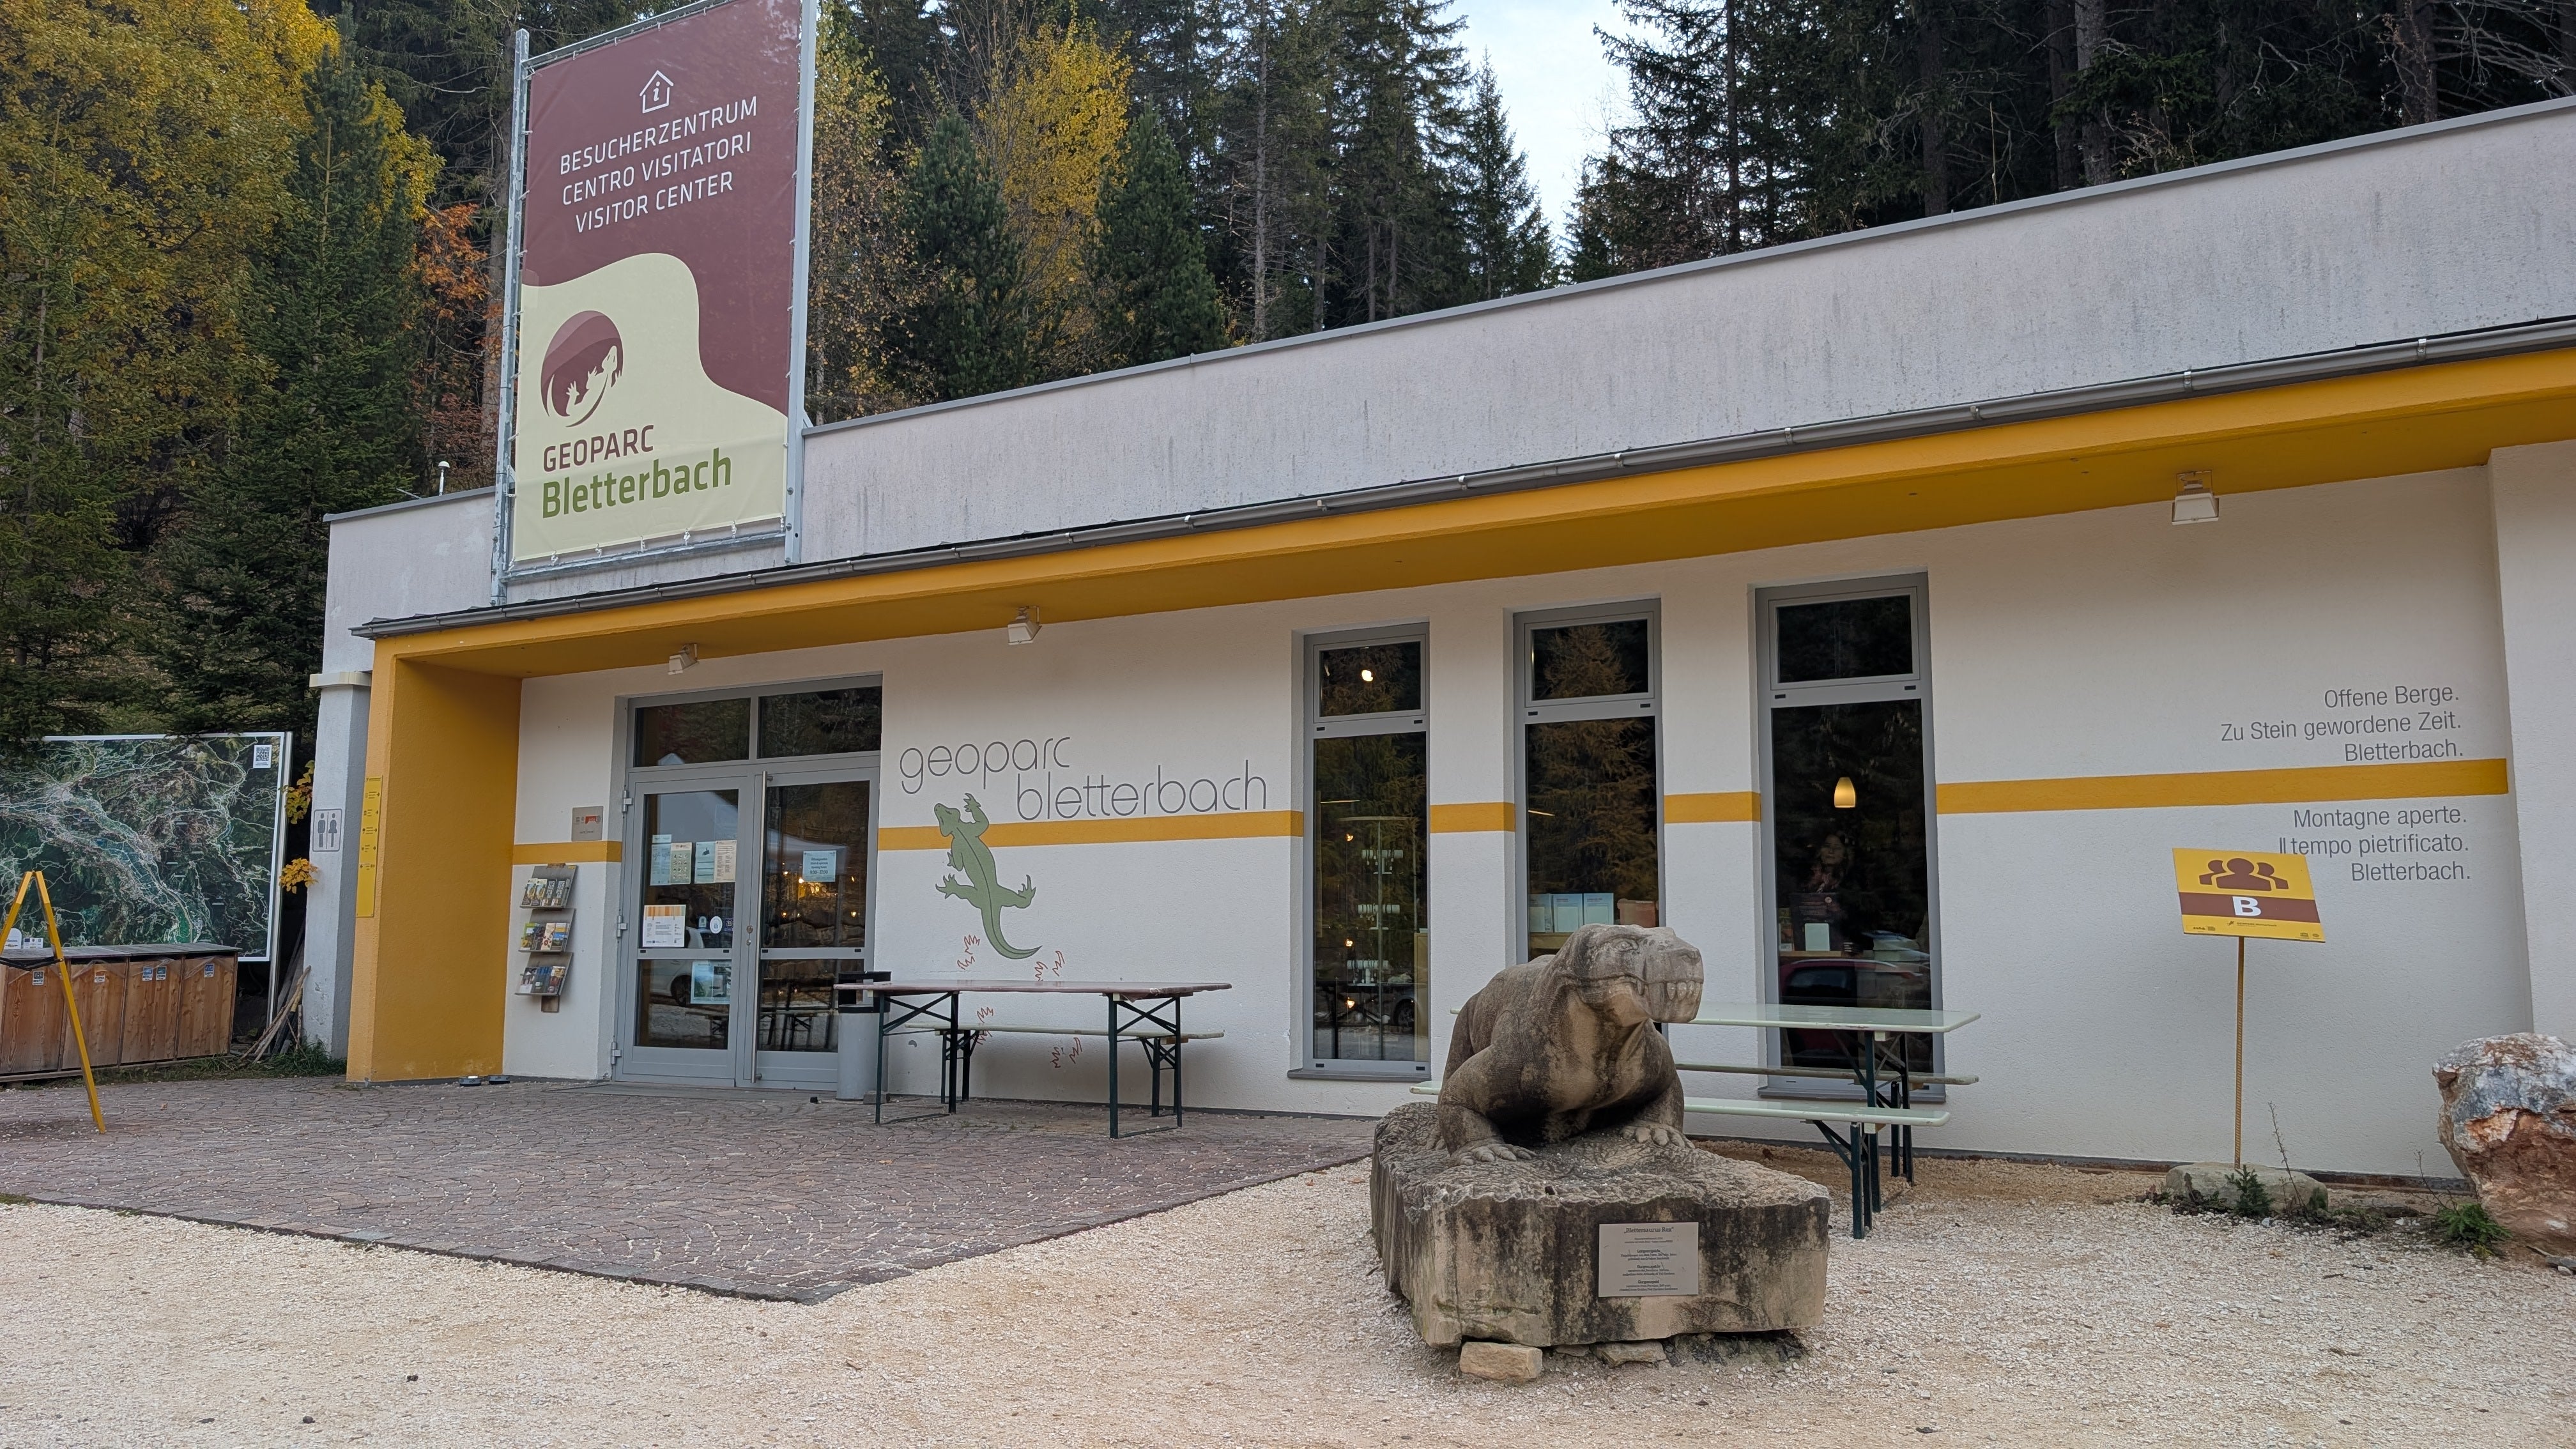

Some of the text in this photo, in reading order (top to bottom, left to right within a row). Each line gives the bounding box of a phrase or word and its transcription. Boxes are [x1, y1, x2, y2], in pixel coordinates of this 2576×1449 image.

[560, 96, 756, 175] BESUCHERZENTRUM
[563, 131, 751, 205] CENTRO VISITATORI
[576, 171, 733, 233] VISITOR CENTER
[543, 424, 654, 472] GEOPARC
[542, 447, 731, 519] Bletterbach
[2324, 686, 2459, 708] Offene Berge.
[2221, 711, 2461, 742] Zu Stein gewordene Zeit.
[900, 737, 1071, 795] geoparc
[2345, 739, 2463, 762] Bletterbach.
[1017, 759, 1266, 821] bletterbach
[2294, 806, 2466, 831] Montagne aperte.
[2279, 833, 2469, 858] Il tempo pietrificato.
[2351, 861, 2470, 881] Bletterbach.
[2232, 896, 2262, 917] B
